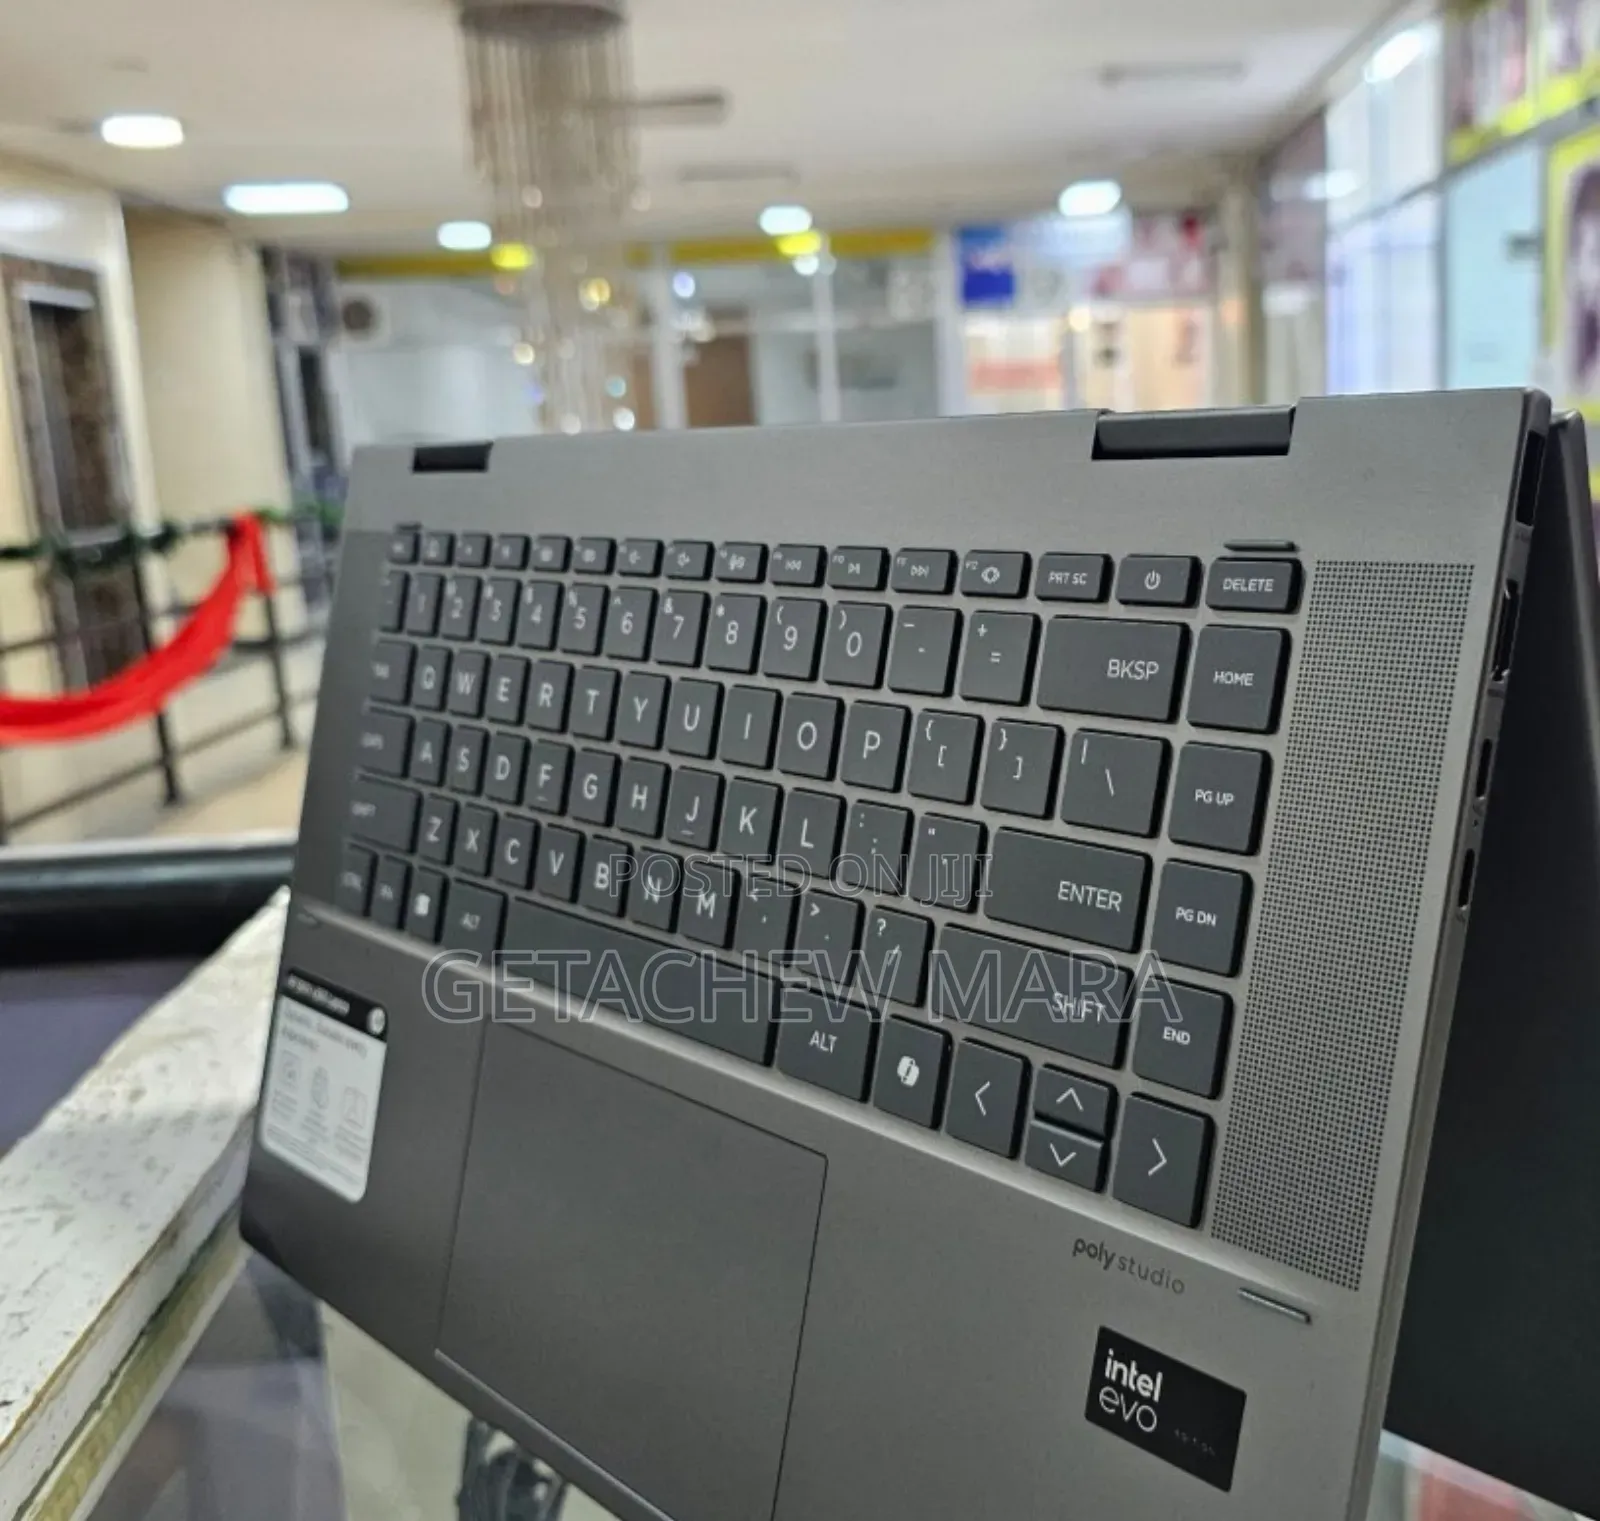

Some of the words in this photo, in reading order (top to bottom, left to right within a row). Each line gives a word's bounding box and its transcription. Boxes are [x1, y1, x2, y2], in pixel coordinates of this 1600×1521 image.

[1048, 571, 1070, 585] PRT
[1072, 572, 1088, 586] SC
[1222, 577, 1274, 593] DELETE
[451, 598, 463, 620] 2
[530, 604, 543, 624] 4
[574, 606, 587, 629] 5
[621, 611, 634, 635] 6
[672, 615, 685, 640] 7
[725, 620, 739, 645] 8
[977, 623, 989, 638] +
[783, 625, 798, 651] 9
[846, 631, 863, 658] 0
[422, 666, 436, 691] Q
[455, 671, 475, 695] W
[1106, 658, 1160, 682] BKSP
[1213, 670, 1254, 687] HOME
[497, 677, 511, 703] E
[539, 683, 554, 708] R
[586, 688, 600, 715] T
[633, 696, 649, 722] Y
[683, 703, 700, 732] U
[743, 712, 752, 741] I
[797, 720, 818, 751] O
[420, 740, 433, 764] A
[863, 729, 881, 759] P
[456, 747, 470, 773] S
[495, 755, 511, 781] D
[538, 763, 554, 789] F
[582, 773, 599, 800] G
[631, 783, 649, 812] H
[685, 795, 700, 823] J
[1195, 788, 1213, 804] PG
[1215, 792, 1234, 807] UP
[427, 815, 443, 844] Z
[738, 805, 758, 835] K
[800, 817, 814, 848] L
[464, 828, 481, 853] X
[504, 837, 521, 865] C
[549, 849, 565, 877] V
[594, 861, 610, 891] B
[644, 874, 662, 905] N
[1057, 880, 1123, 913] ENTER
[696, 890, 717, 920] M
[1175, 906, 1194, 923] PG
[1196, 910, 1218, 928] DN
[1051, 991, 1107, 1024] SHIFT
[809, 1029, 838, 1054] ALT
[1162, 1026, 1191, 1046] END
[1104, 1347, 1164, 1403] intel
[1098, 1385, 1158, 1433] evo
